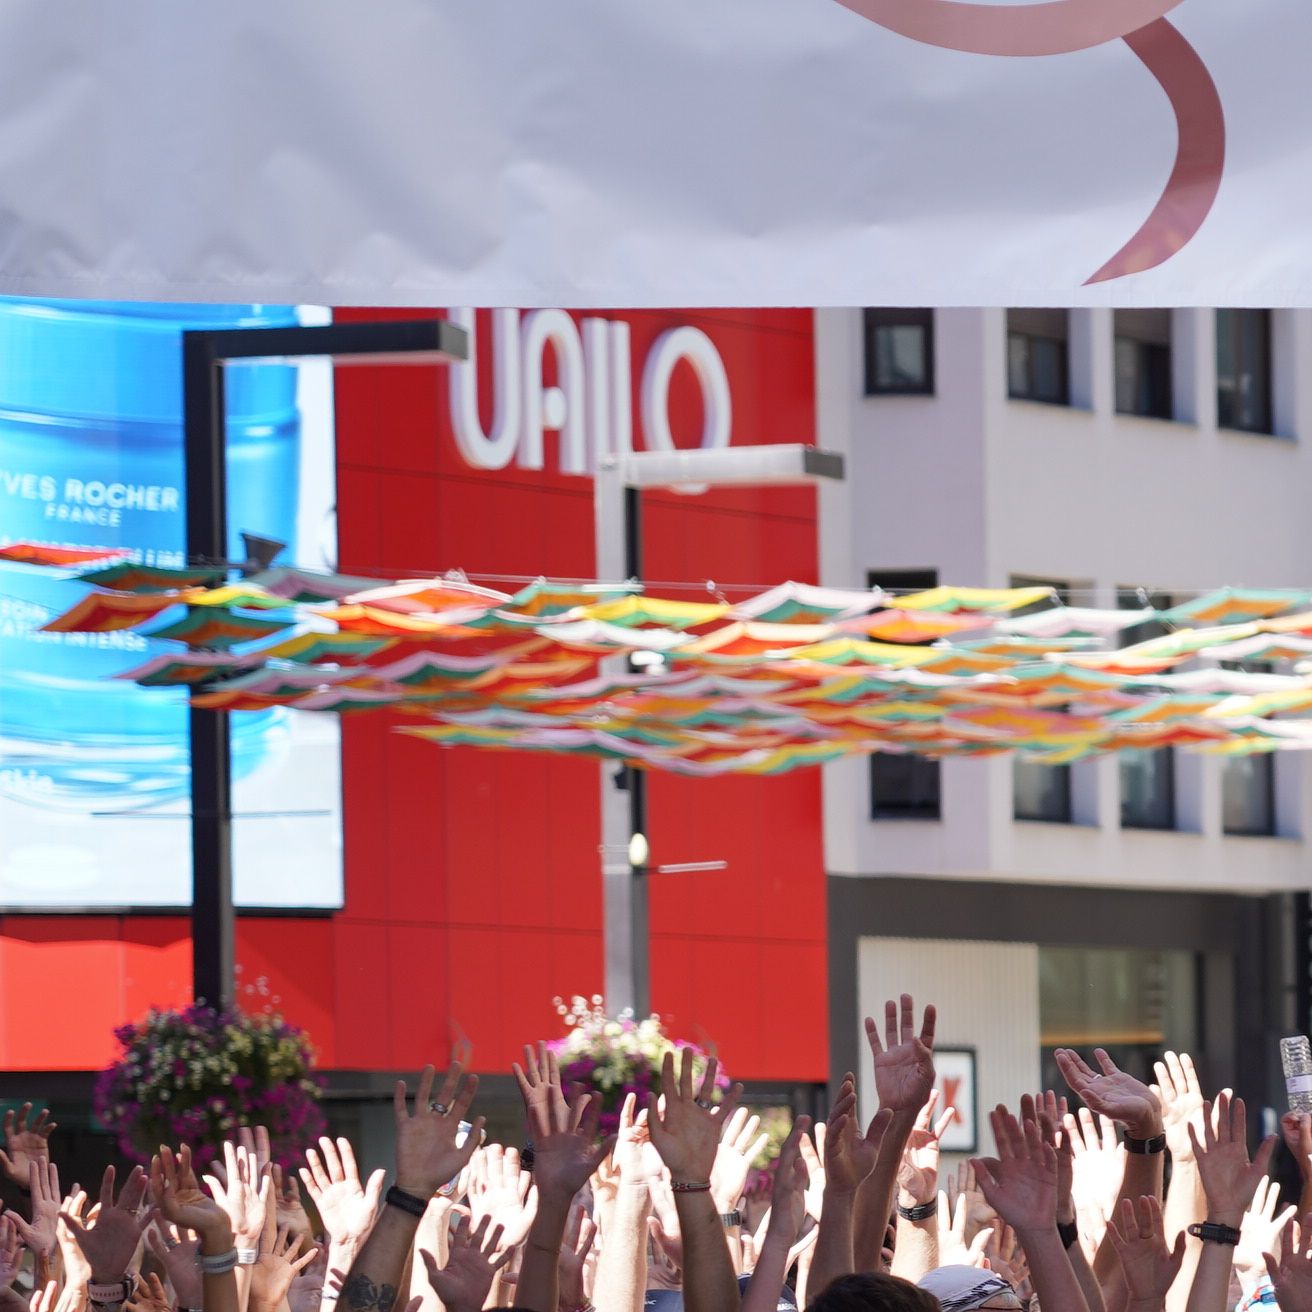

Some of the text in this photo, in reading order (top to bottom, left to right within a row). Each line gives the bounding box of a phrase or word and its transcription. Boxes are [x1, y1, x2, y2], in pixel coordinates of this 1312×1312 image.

[0, 472, 179, 512] VES ROCHER
[45, 502, 121, 527] FRANCE
